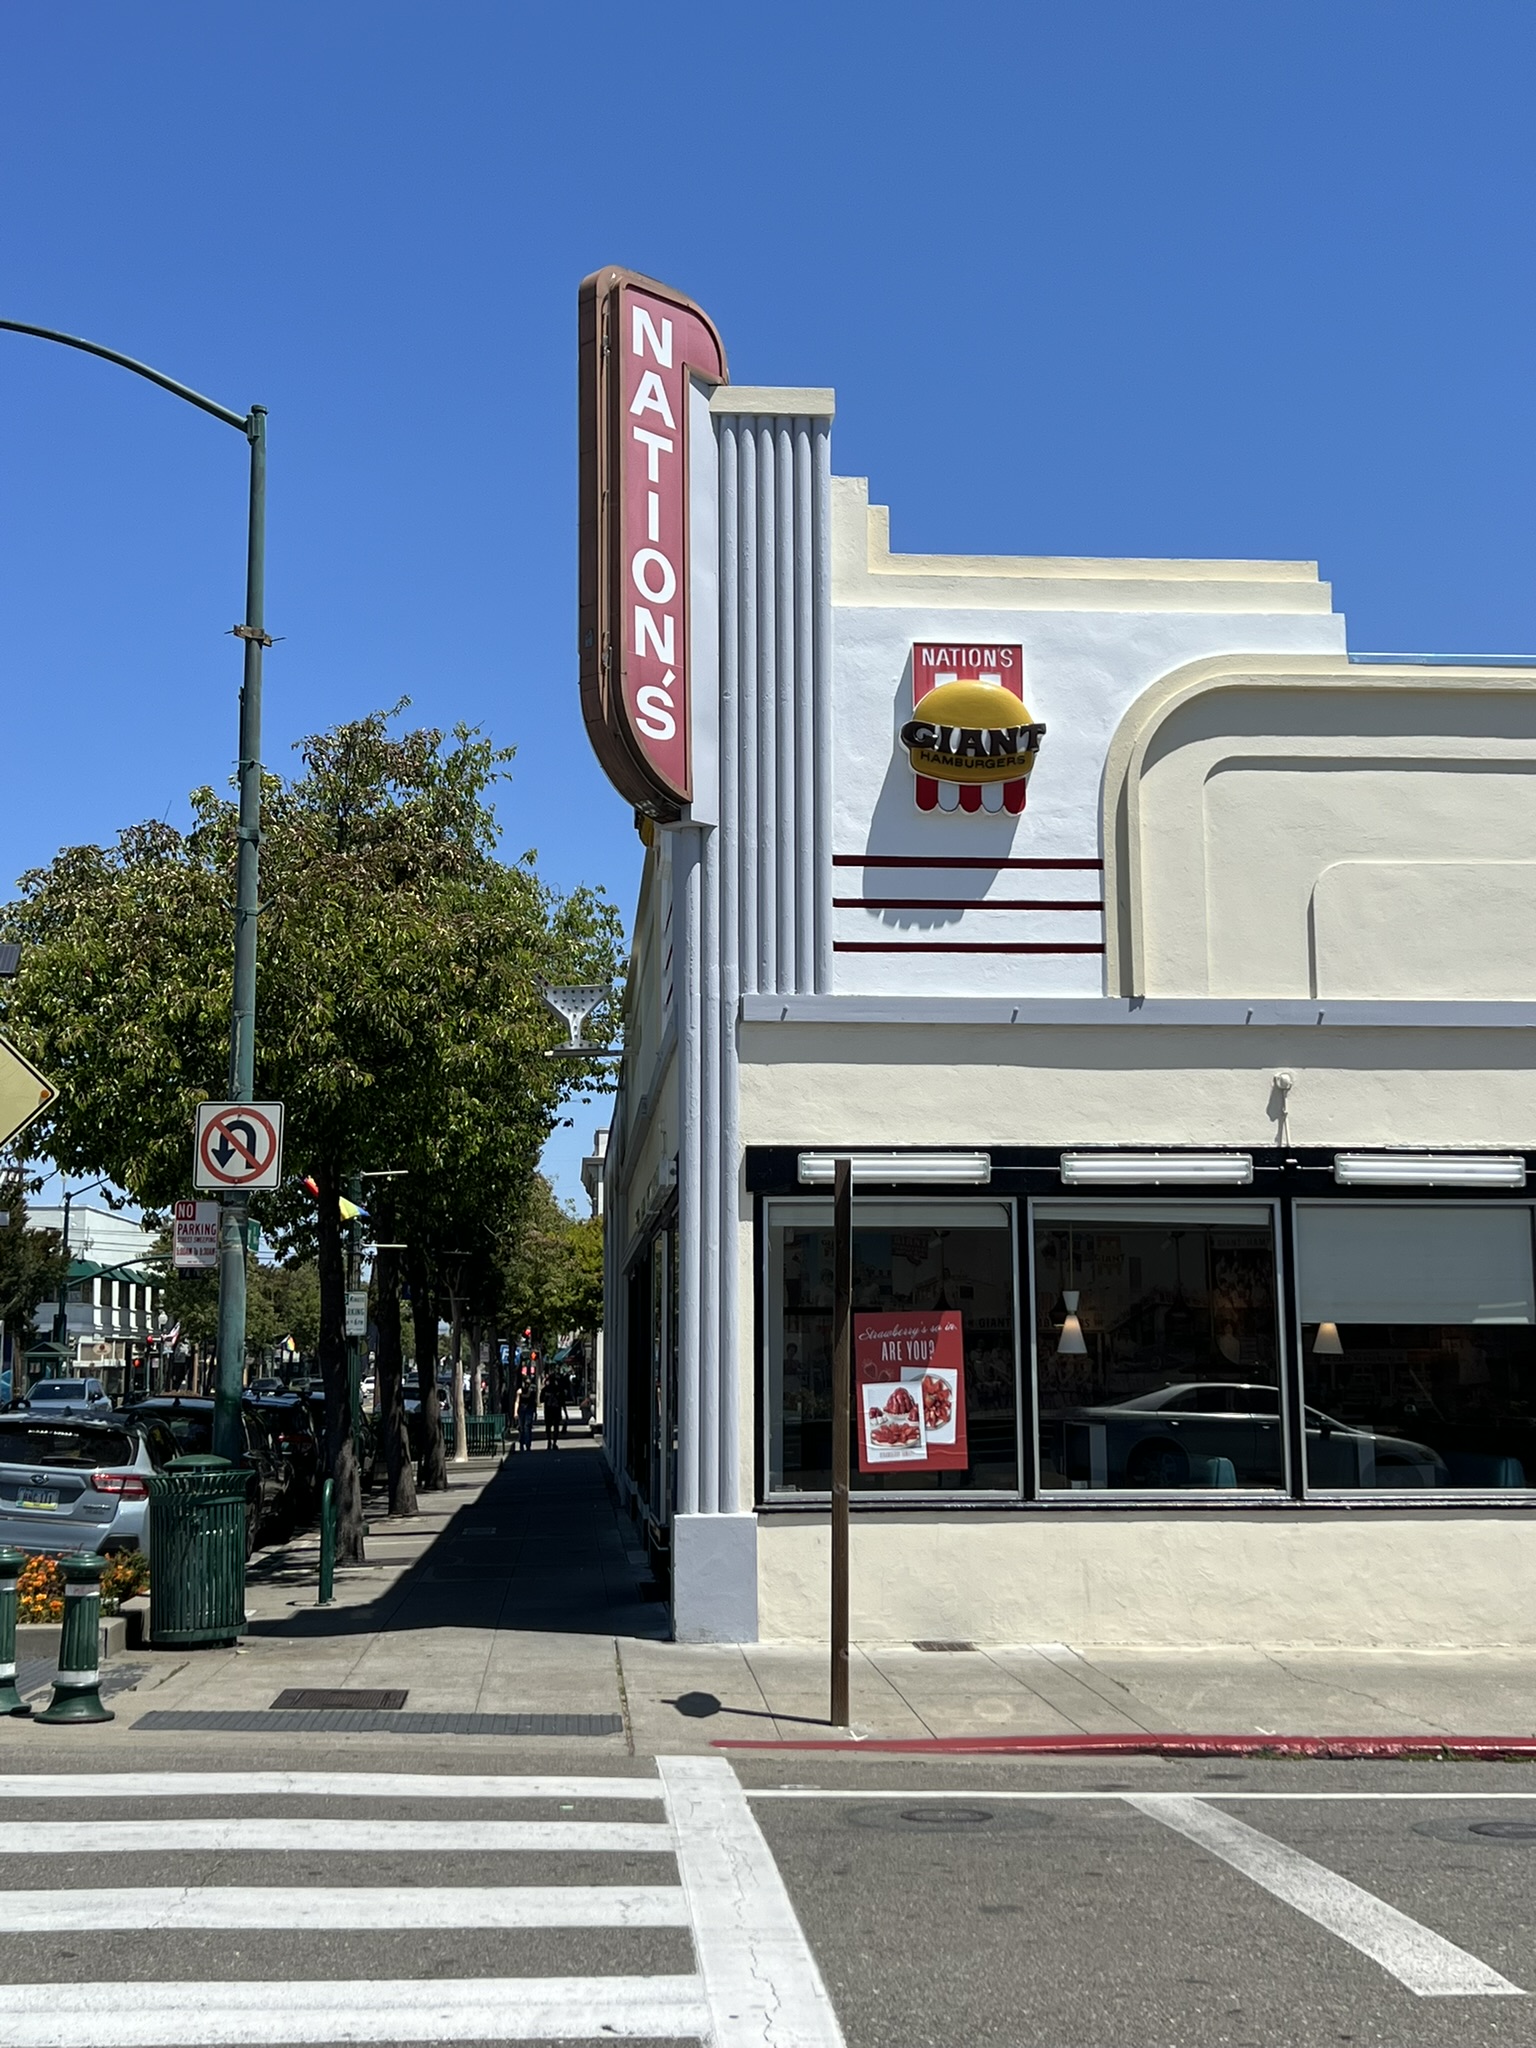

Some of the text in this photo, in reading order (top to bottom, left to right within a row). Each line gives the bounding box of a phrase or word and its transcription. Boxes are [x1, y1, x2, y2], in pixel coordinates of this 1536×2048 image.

[628, 303, 677, 742] NATION'S
[922, 647, 1014, 668] NATION'S
[901, 720, 1047, 757] GIANT
[919, 750, 1026, 769] HAMBURGERS
[178, 1203, 194, 1219] NO
[177, 1223, 216, 1236] PARKING
[859, 1321, 927, 1341] Strawberry's
[978, 1317, 1011, 1328] GIANT
[882, 1339, 935, 1361] ARE YOU?
